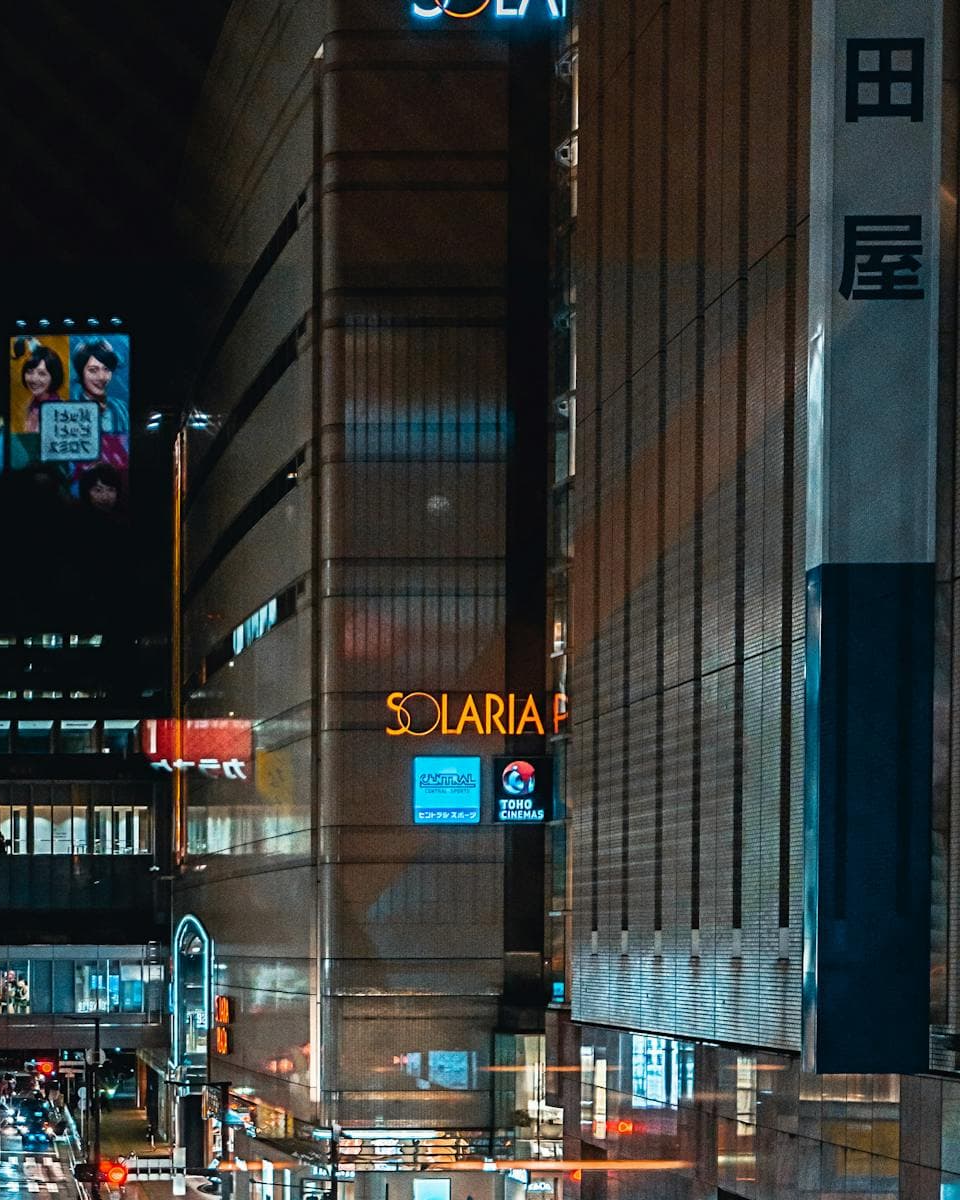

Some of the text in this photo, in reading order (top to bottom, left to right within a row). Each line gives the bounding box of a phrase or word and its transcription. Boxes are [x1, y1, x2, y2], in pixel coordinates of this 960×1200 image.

[385, 692, 544, 736] SOLARIA
[501, 799, 532, 809] TOHO
[500, 809, 545, 820] CINEMAS
